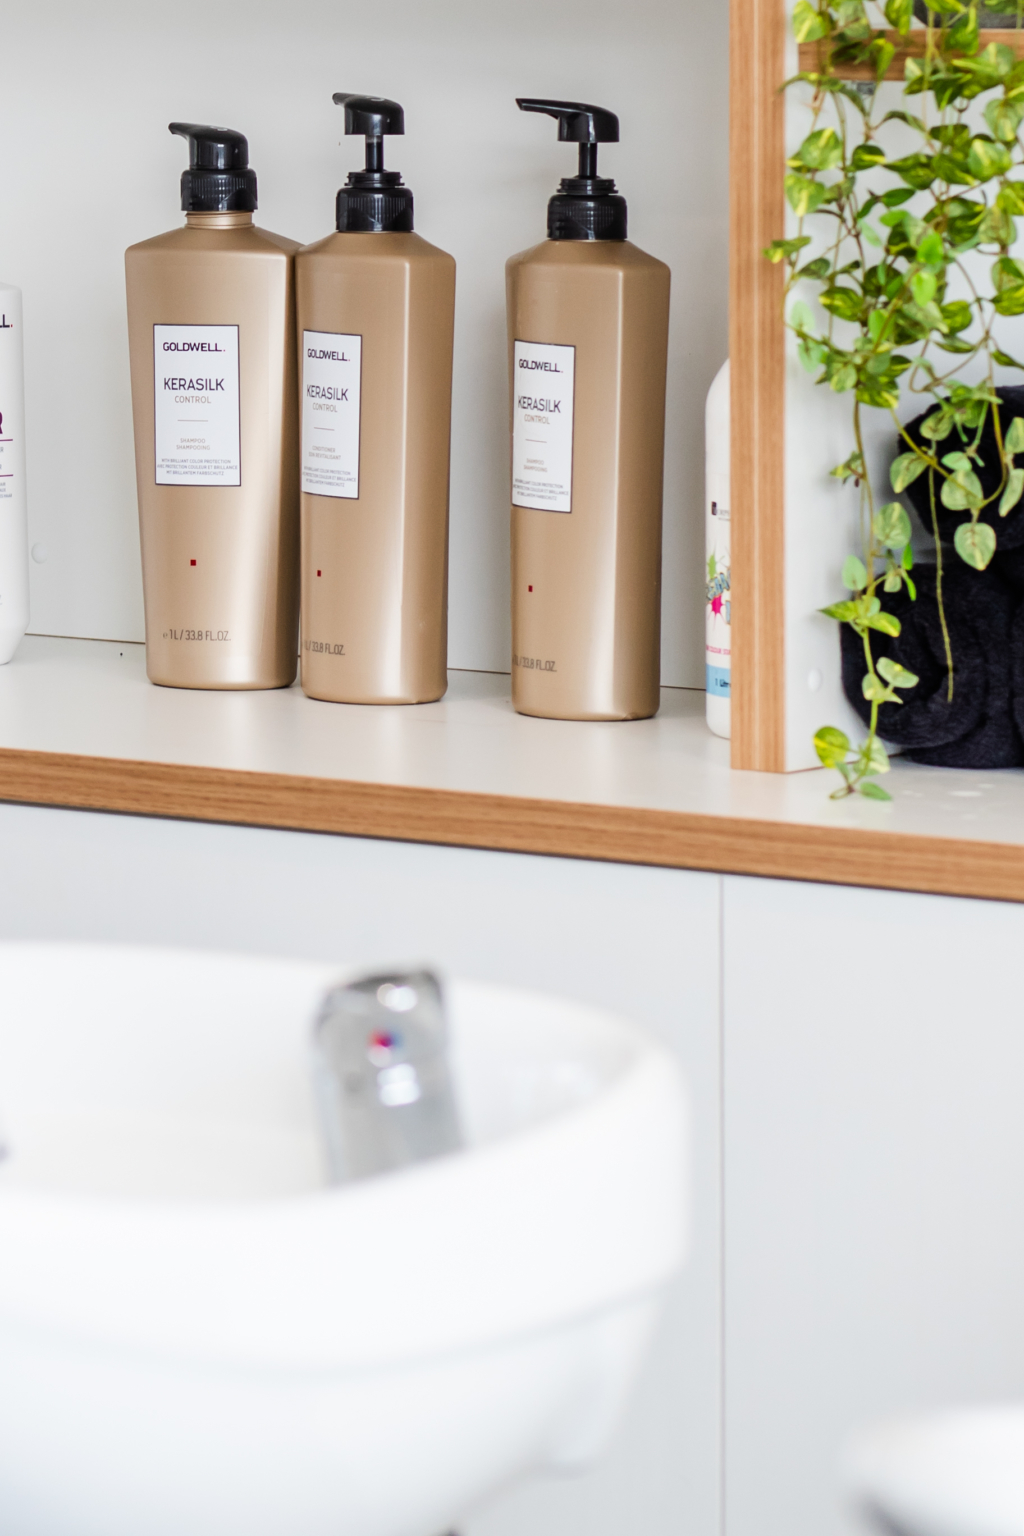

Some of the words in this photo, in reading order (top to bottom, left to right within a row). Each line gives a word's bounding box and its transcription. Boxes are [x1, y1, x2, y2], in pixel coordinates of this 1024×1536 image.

[164, 378, 225, 391] KERASILK
[307, 384, 348, 401] KERASILK
[313, 403, 337, 413] CONTROL
[518, 395, 561, 413] KERASILK
[524, 414, 550, 425] CONTROL
[185, 630, 203, 641] 33.8
